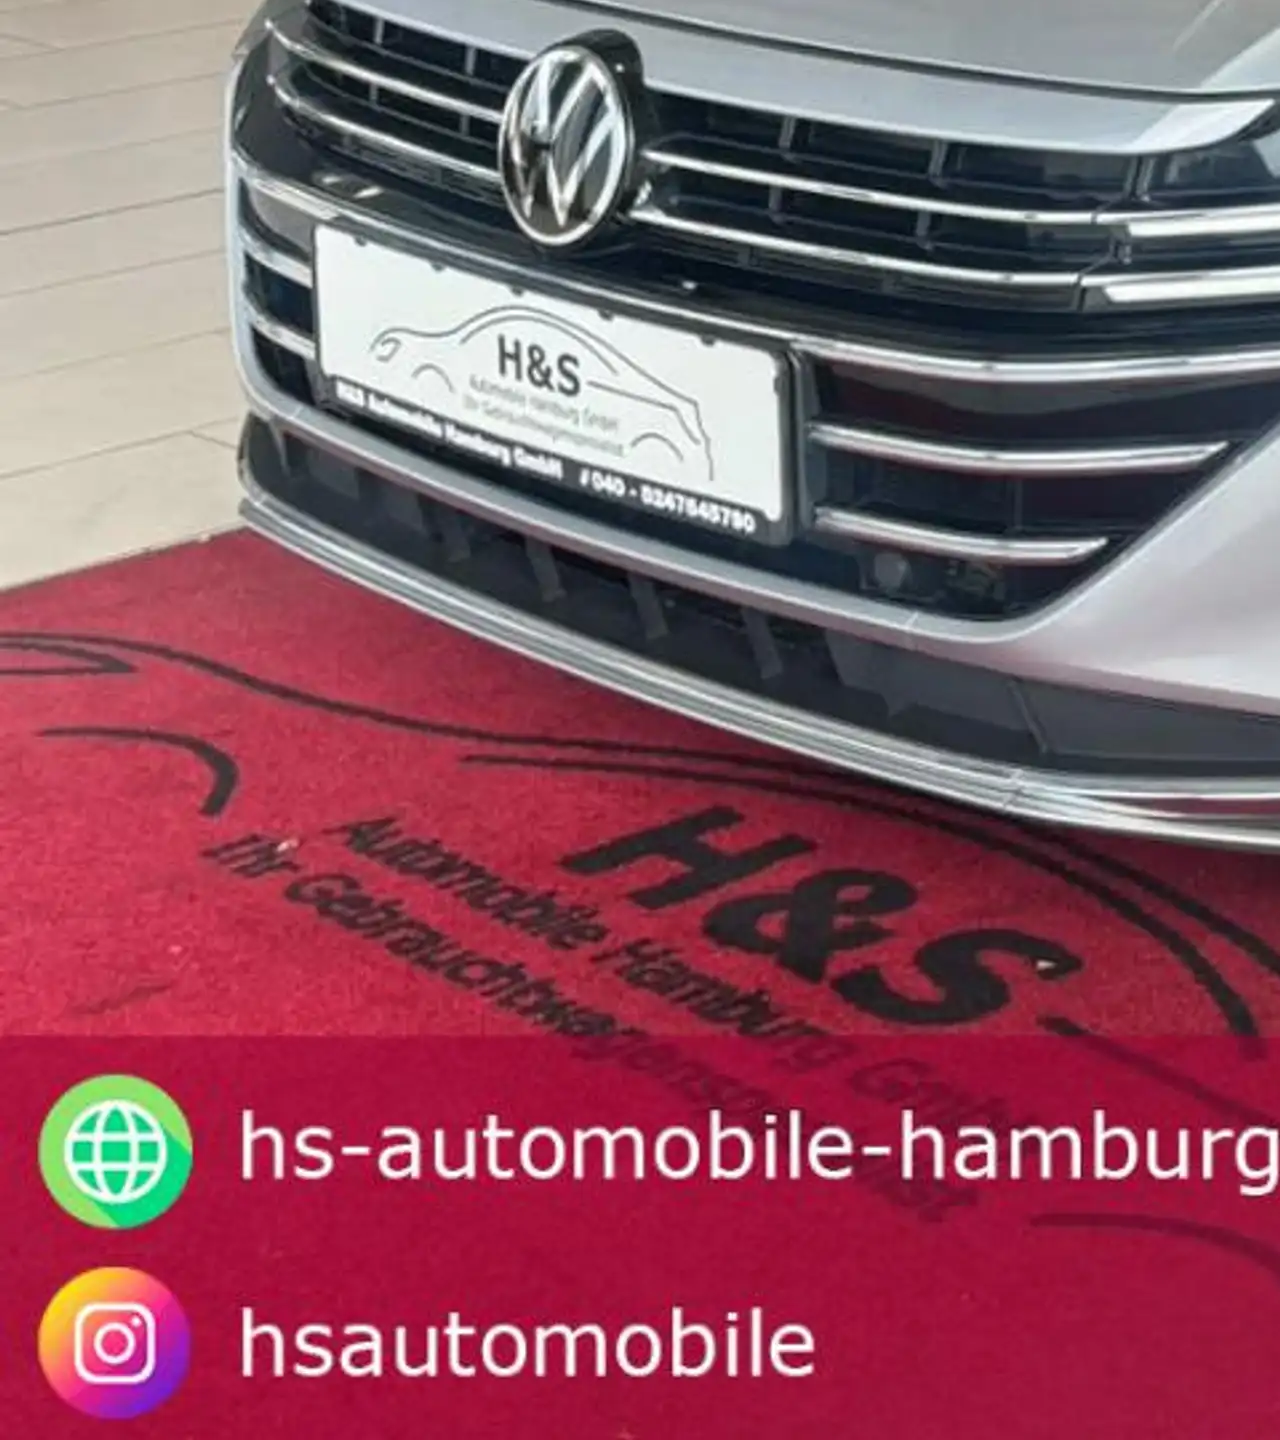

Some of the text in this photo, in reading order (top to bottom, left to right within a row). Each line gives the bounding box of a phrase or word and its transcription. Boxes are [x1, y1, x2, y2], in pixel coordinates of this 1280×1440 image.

[497, 334, 581, 397] H&S
[321, 817, 609, 950] Automobile
[560, 805, 1084, 1026] H&S
